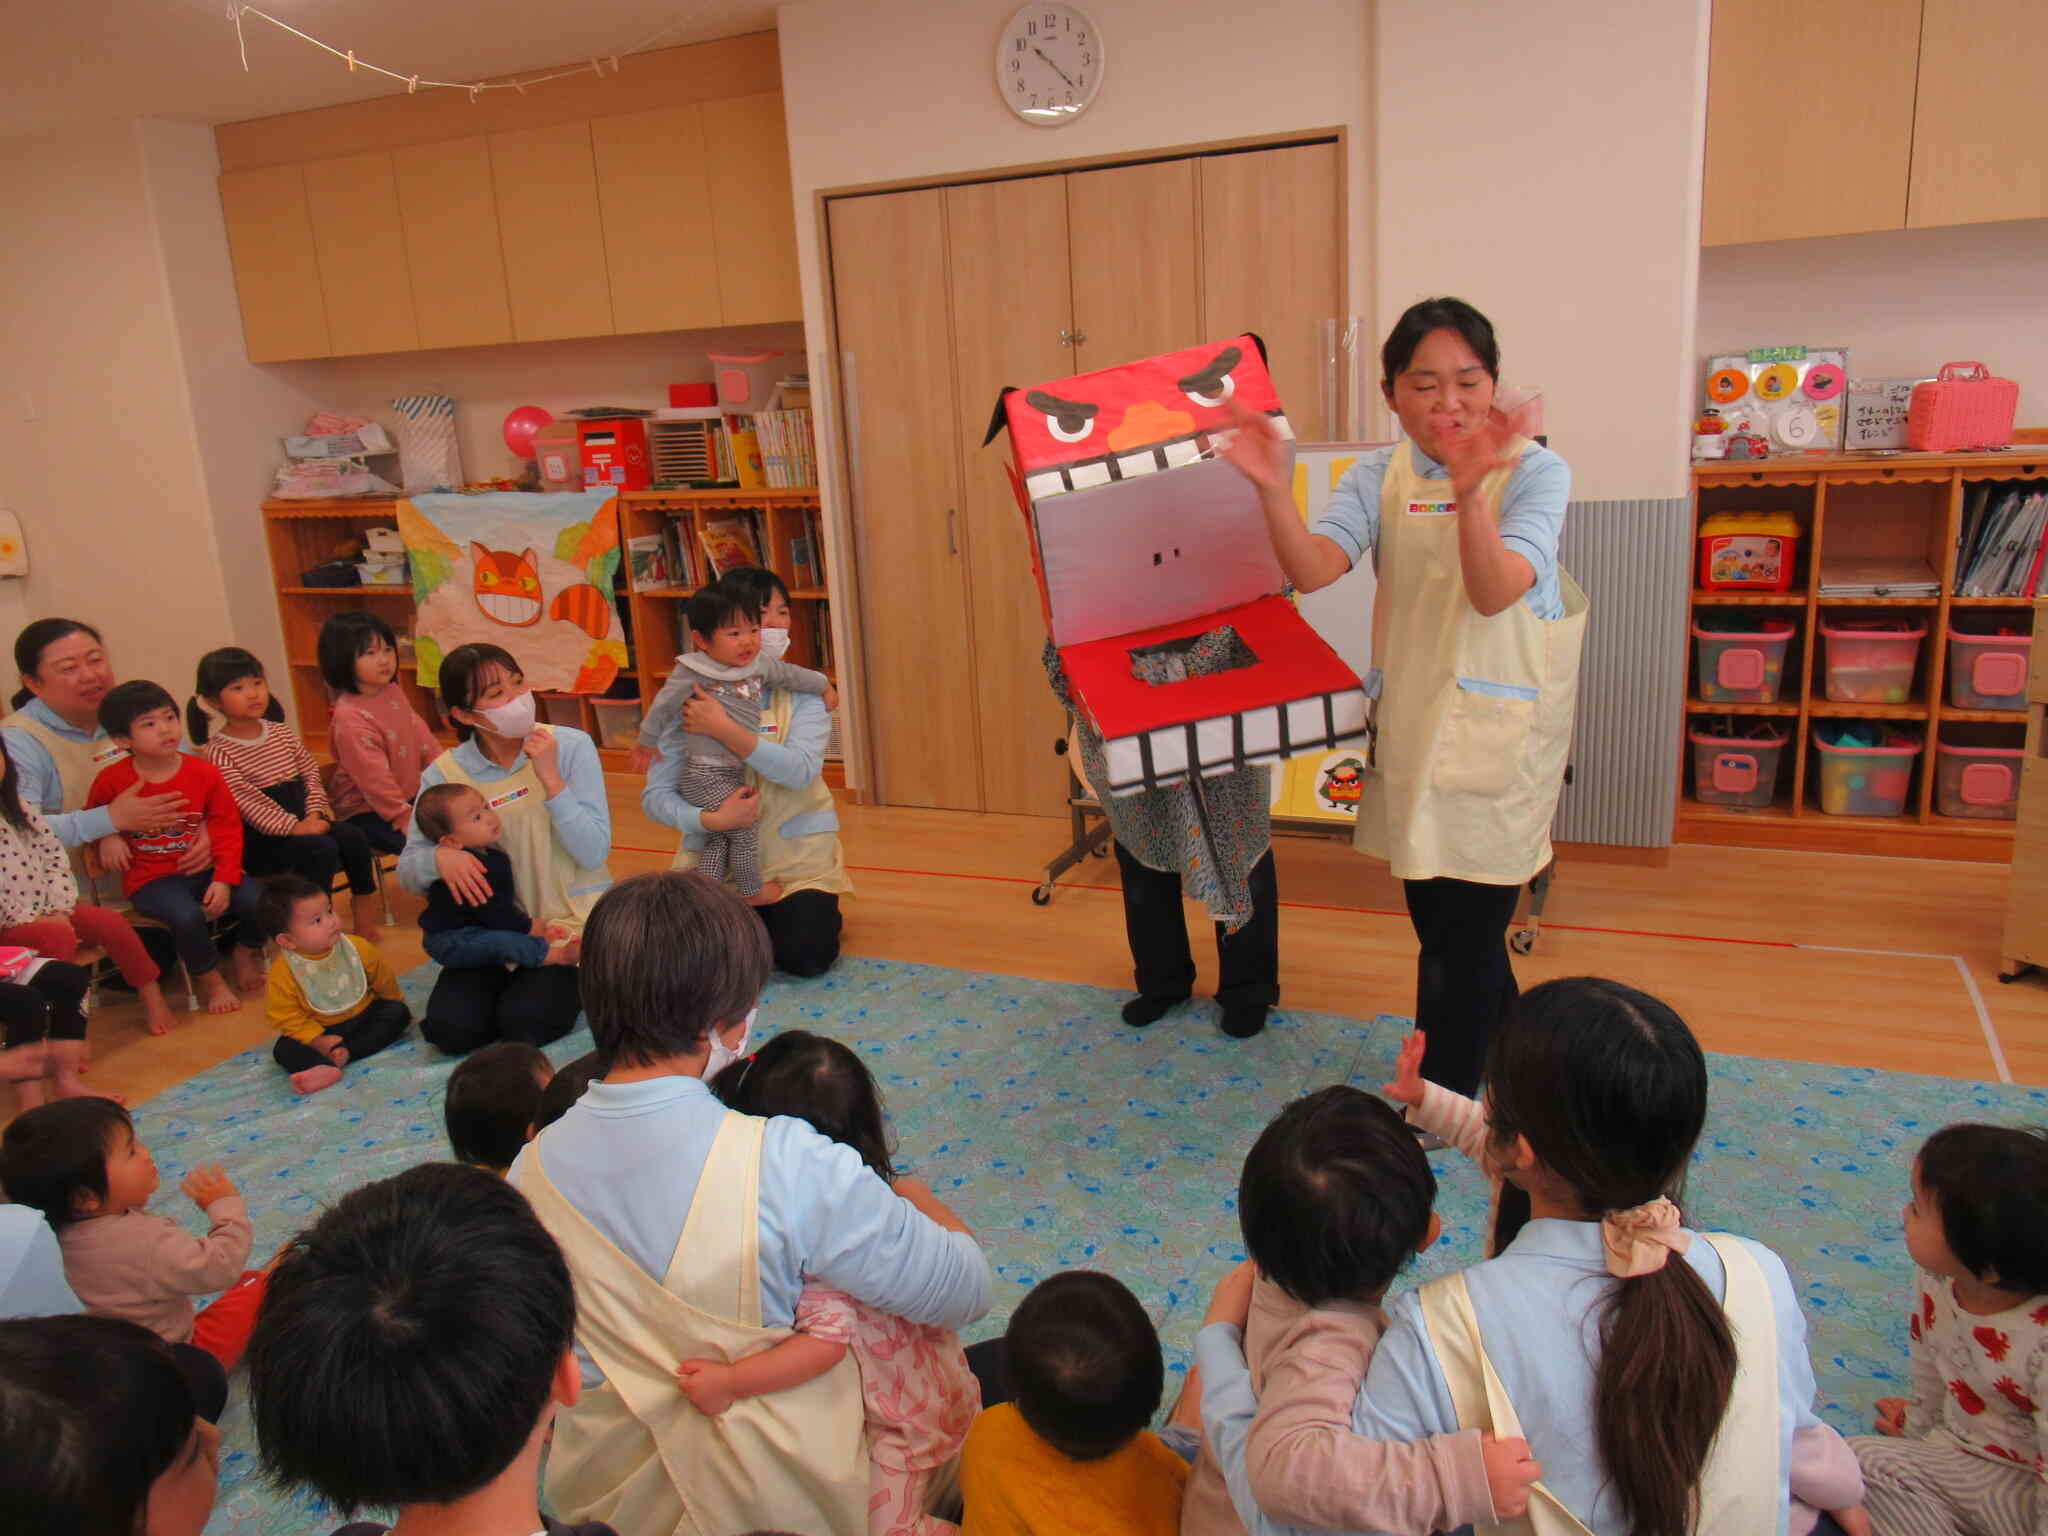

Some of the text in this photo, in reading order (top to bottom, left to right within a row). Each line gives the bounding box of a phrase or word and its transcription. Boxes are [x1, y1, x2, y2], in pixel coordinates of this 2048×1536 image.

[1028, 20, 1037, 36] 11
[1043, 13, 1056, 28] 12
[1065, 17, 1070, 32] 1
[1016, 38, 1027, 52] 10
[1077, 31, 1086, 46] 2
[1011, 58, 1020, 73] 9
[1082, 52, 1090, 67] 3
[1017, 79, 1025, 93] 8
[1030, 93, 1038, 107] 7
[1789, 416, 1805, 439] 6
